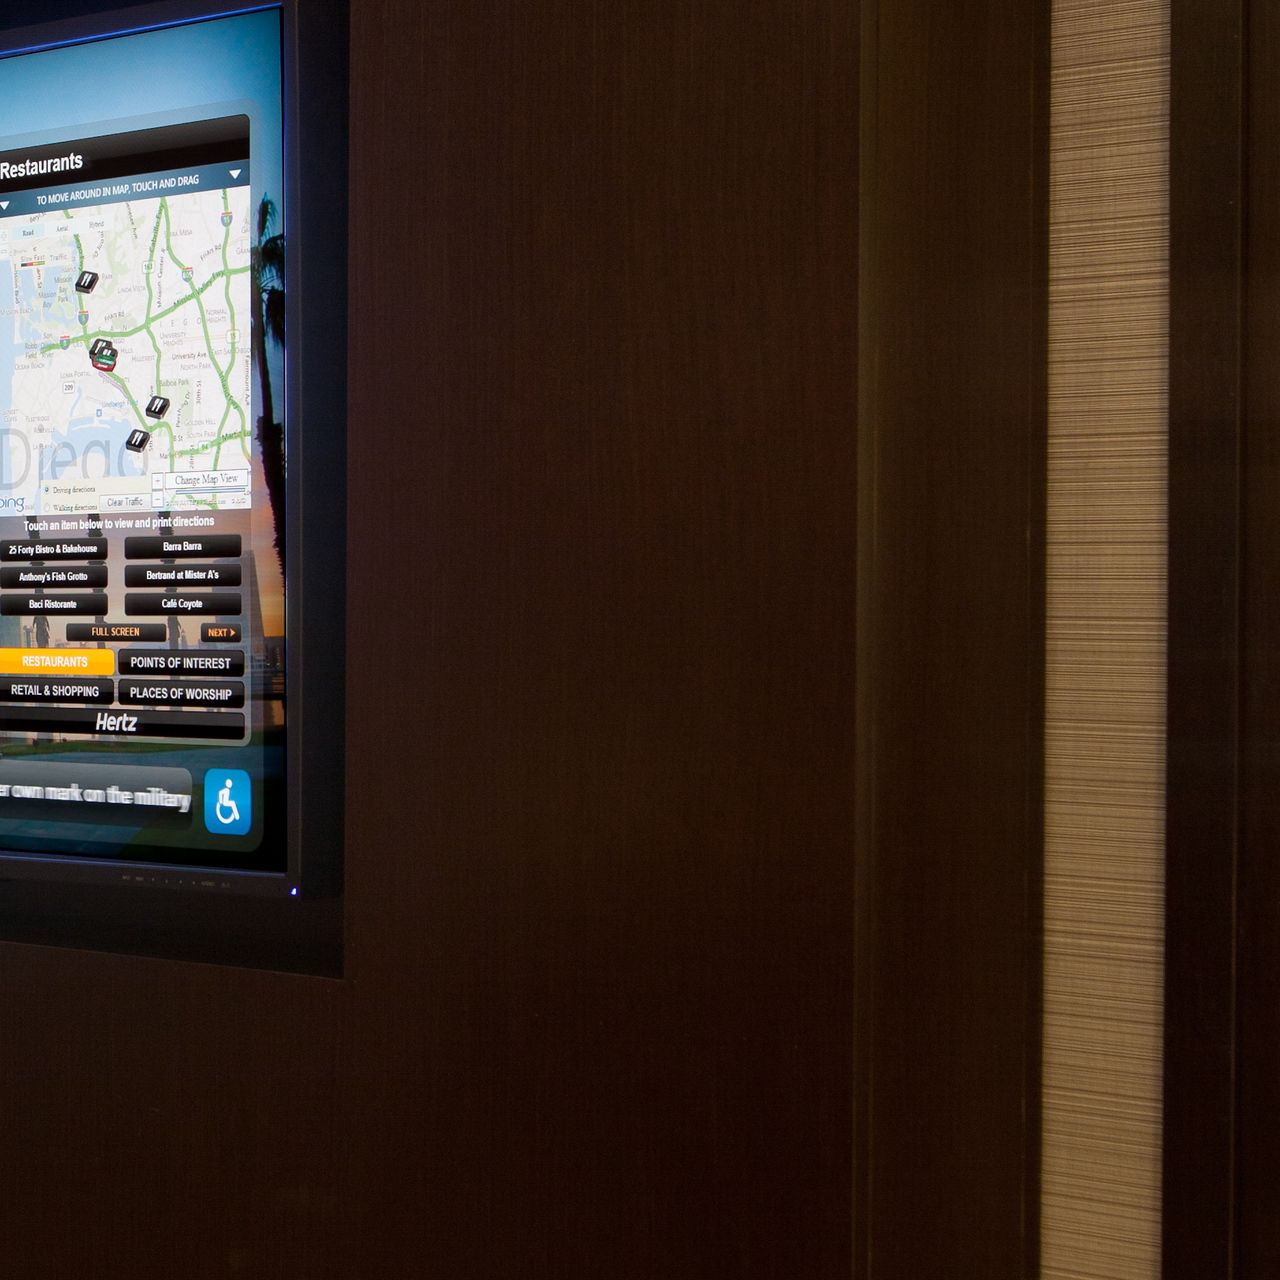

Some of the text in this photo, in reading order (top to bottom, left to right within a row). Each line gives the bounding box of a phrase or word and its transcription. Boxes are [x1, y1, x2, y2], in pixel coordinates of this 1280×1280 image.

[0, 153, 83, 180] Restaurants
[37, 174, 200, 205] TO MOVE AROUND IN MAP, TOUCH AND DRAG
[175, 472, 239, 487] Change Map View
[24, 515, 215, 532] Touch an item below to view and print directions
[146, 569, 219, 581] Bertrand at Mister A's
[29, 599, 77, 609] Baci Ristorante
[162, 598, 203, 611] Café Coyote
[91, 626, 140, 637] FULL SCREEN
[207, 627, 227, 637] NEXT
[22, 655, 89, 668] RESTAURANTS
[131, 656, 231, 670] POINTS OF INTEREST
[11, 684, 100, 698] RETAIL & SHOPPING
[130, 686, 233, 701] PLACES OF WORSHIP
[96, 712, 138, 732] Hertz
